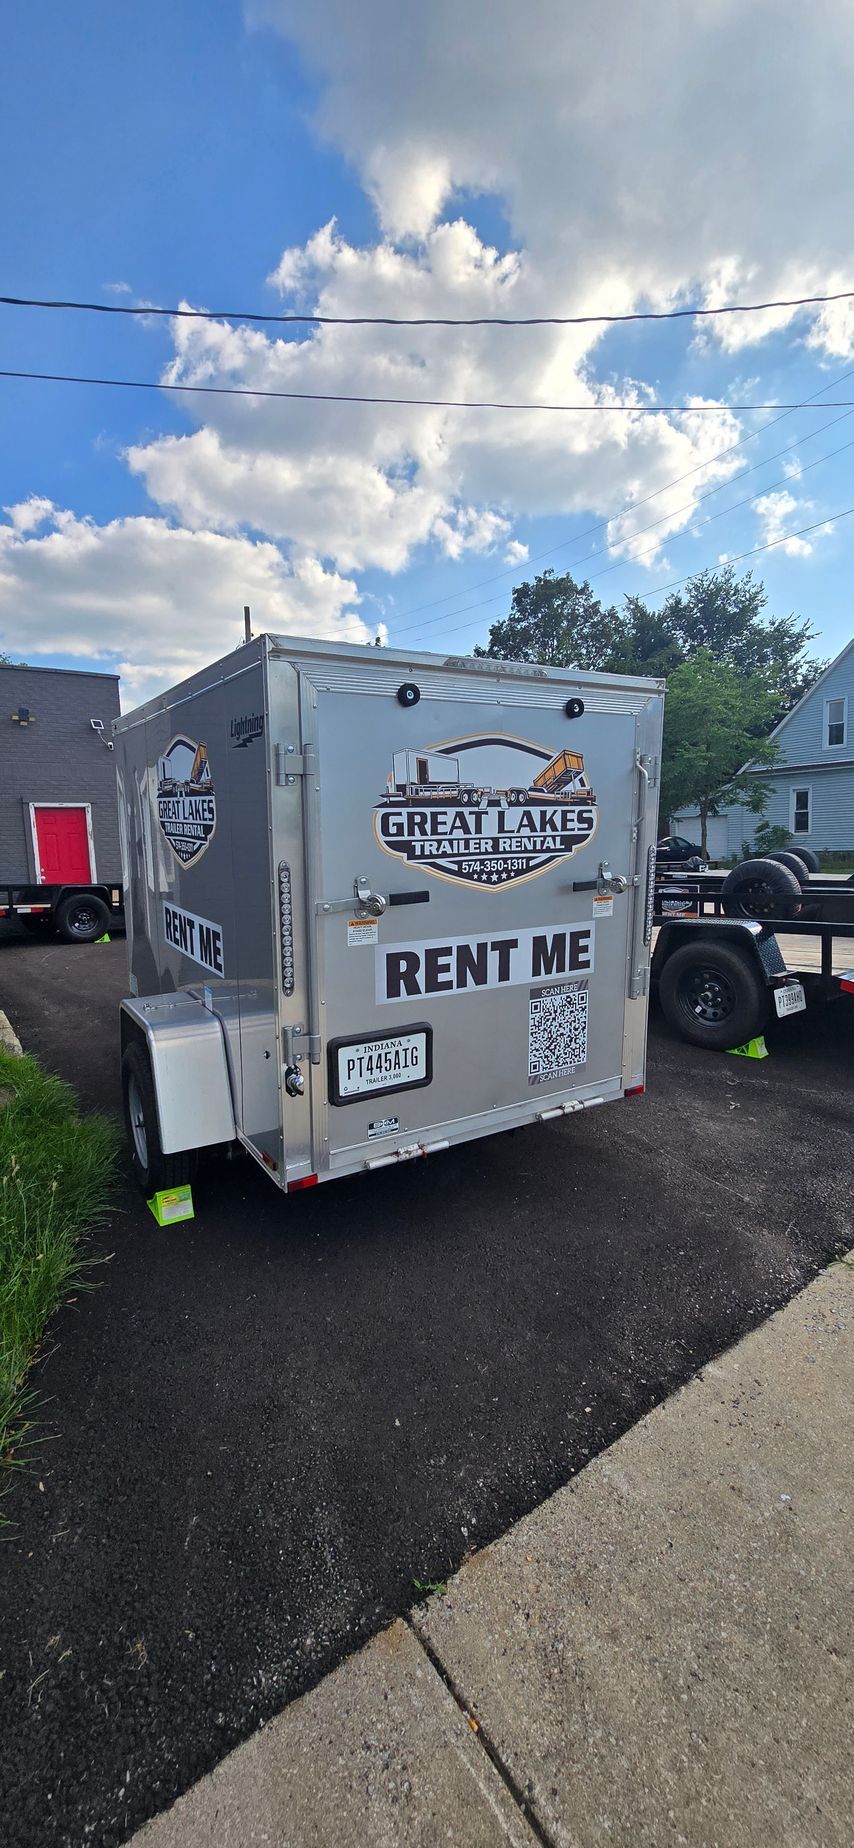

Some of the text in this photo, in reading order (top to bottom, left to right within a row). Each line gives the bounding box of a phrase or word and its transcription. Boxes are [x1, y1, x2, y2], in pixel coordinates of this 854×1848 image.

[231, 713, 264, 740] Lightning
[159, 799, 215, 822] GREAT LAKES
[164, 822, 206, 837] TRAILER RENTAL
[381, 809, 594, 837] GREAT LAKES
[412, 836, 565, 856] TRAILER RENTAL
[461, 858, 527, 873] 574-350-1311
[164, 905, 223, 973] RENT ME
[386, 929, 591, 999] RENT ME
[541, 983, 578, 997] SCAN HERE
[363, 1040, 403, 1054] INDIANA
[347, 1046, 419, 1081] PT445AIG
[366, 1072, 402, 1085] TRAILER 3,000
[539, 1066, 576, 1082] SCAN HERE
